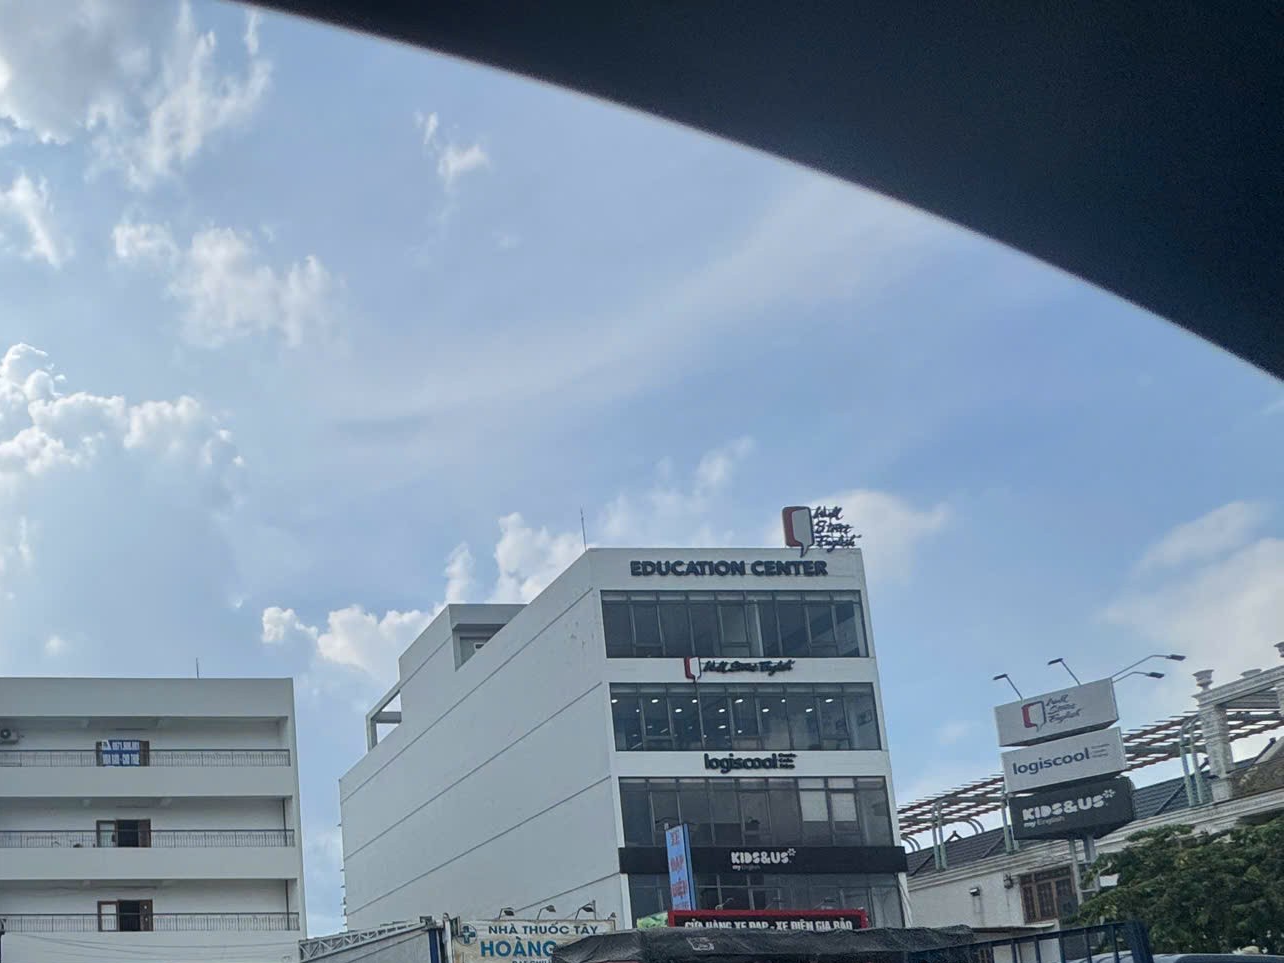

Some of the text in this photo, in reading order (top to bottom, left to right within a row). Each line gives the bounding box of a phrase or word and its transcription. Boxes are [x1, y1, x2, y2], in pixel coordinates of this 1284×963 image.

[630, 561, 828, 577] EDUCATION CENTER
[704, 753, 777, 774] logiscool
[1013, 747, 1090, 775] logiscool
[1022, 795, 1104, 821] KIDS&US
[731, 851, 789, 864] KIDS&US
[488, 922, 598, 934] NHÀ THUỐC TÂY
